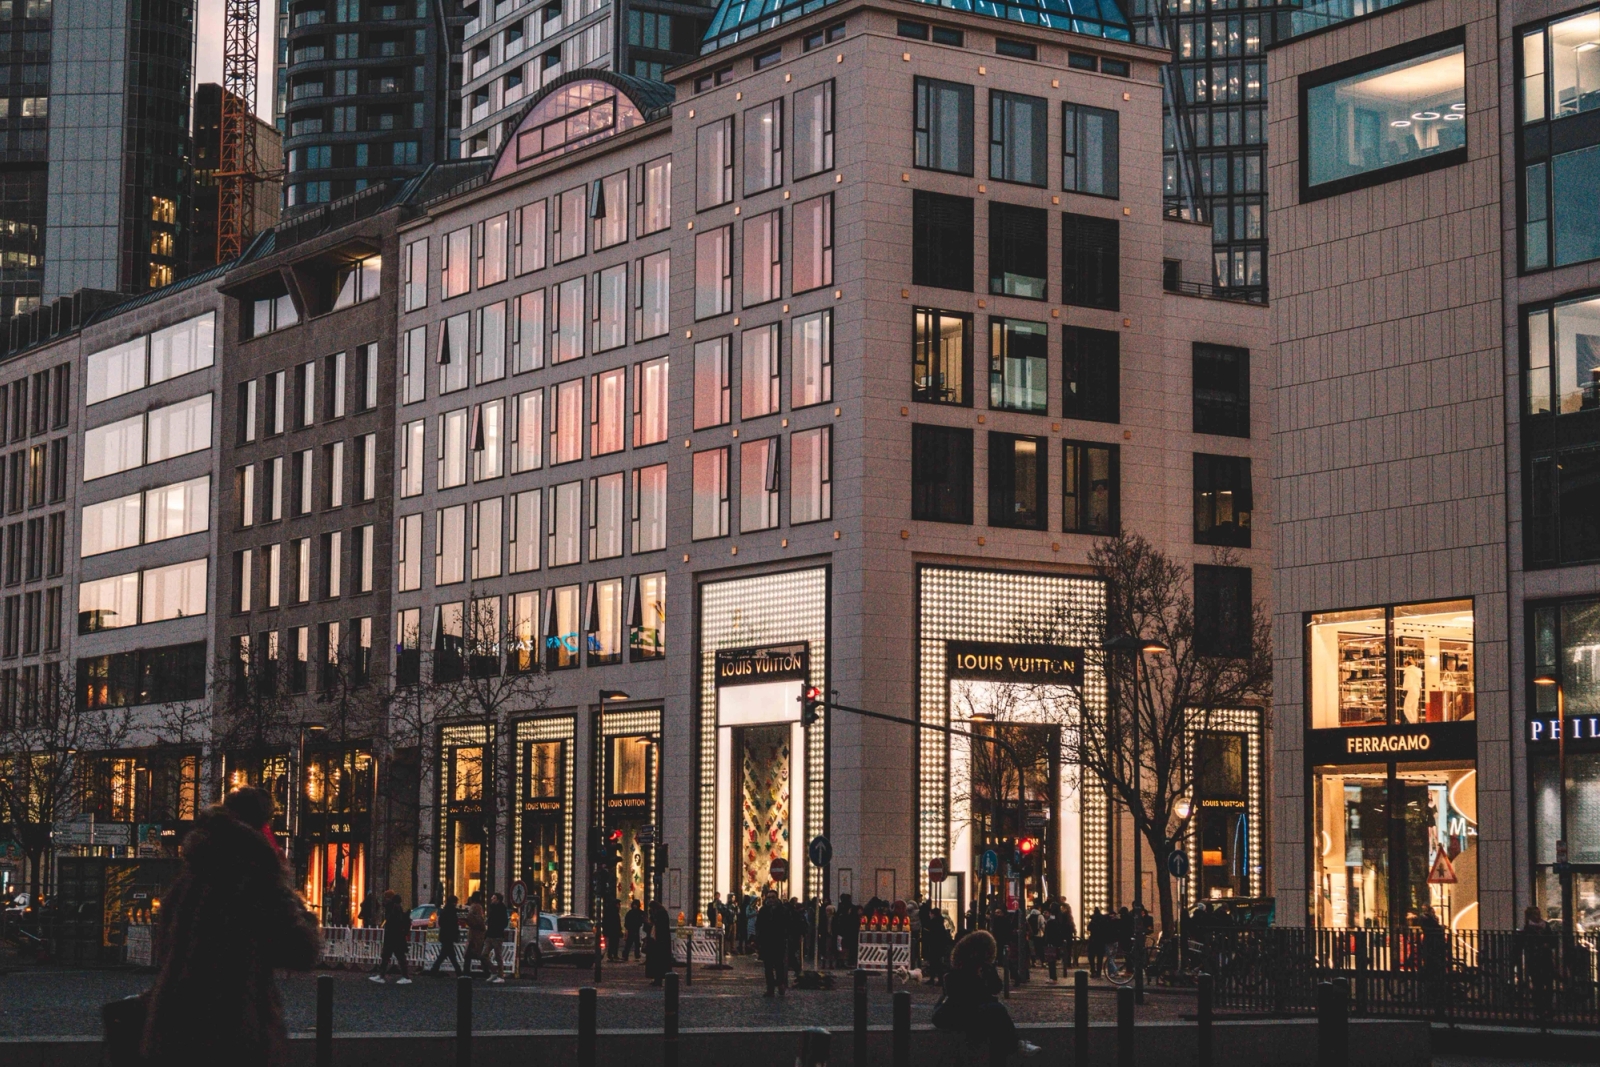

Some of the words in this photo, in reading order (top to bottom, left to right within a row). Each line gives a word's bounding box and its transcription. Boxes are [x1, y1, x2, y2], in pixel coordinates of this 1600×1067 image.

[721, 660, 752, 677] LOUIS
[755, 655, 802, 674] VUITTON
[957, 653, 1003, 671] LOUIS
[1347, 734, 1431, 753] FERRAGAMO
[608, 799, 622, 808] LOUIS
[623, 798, 646, 807] VUITTON
[1202, 799, 1219, 807] LOUIS
